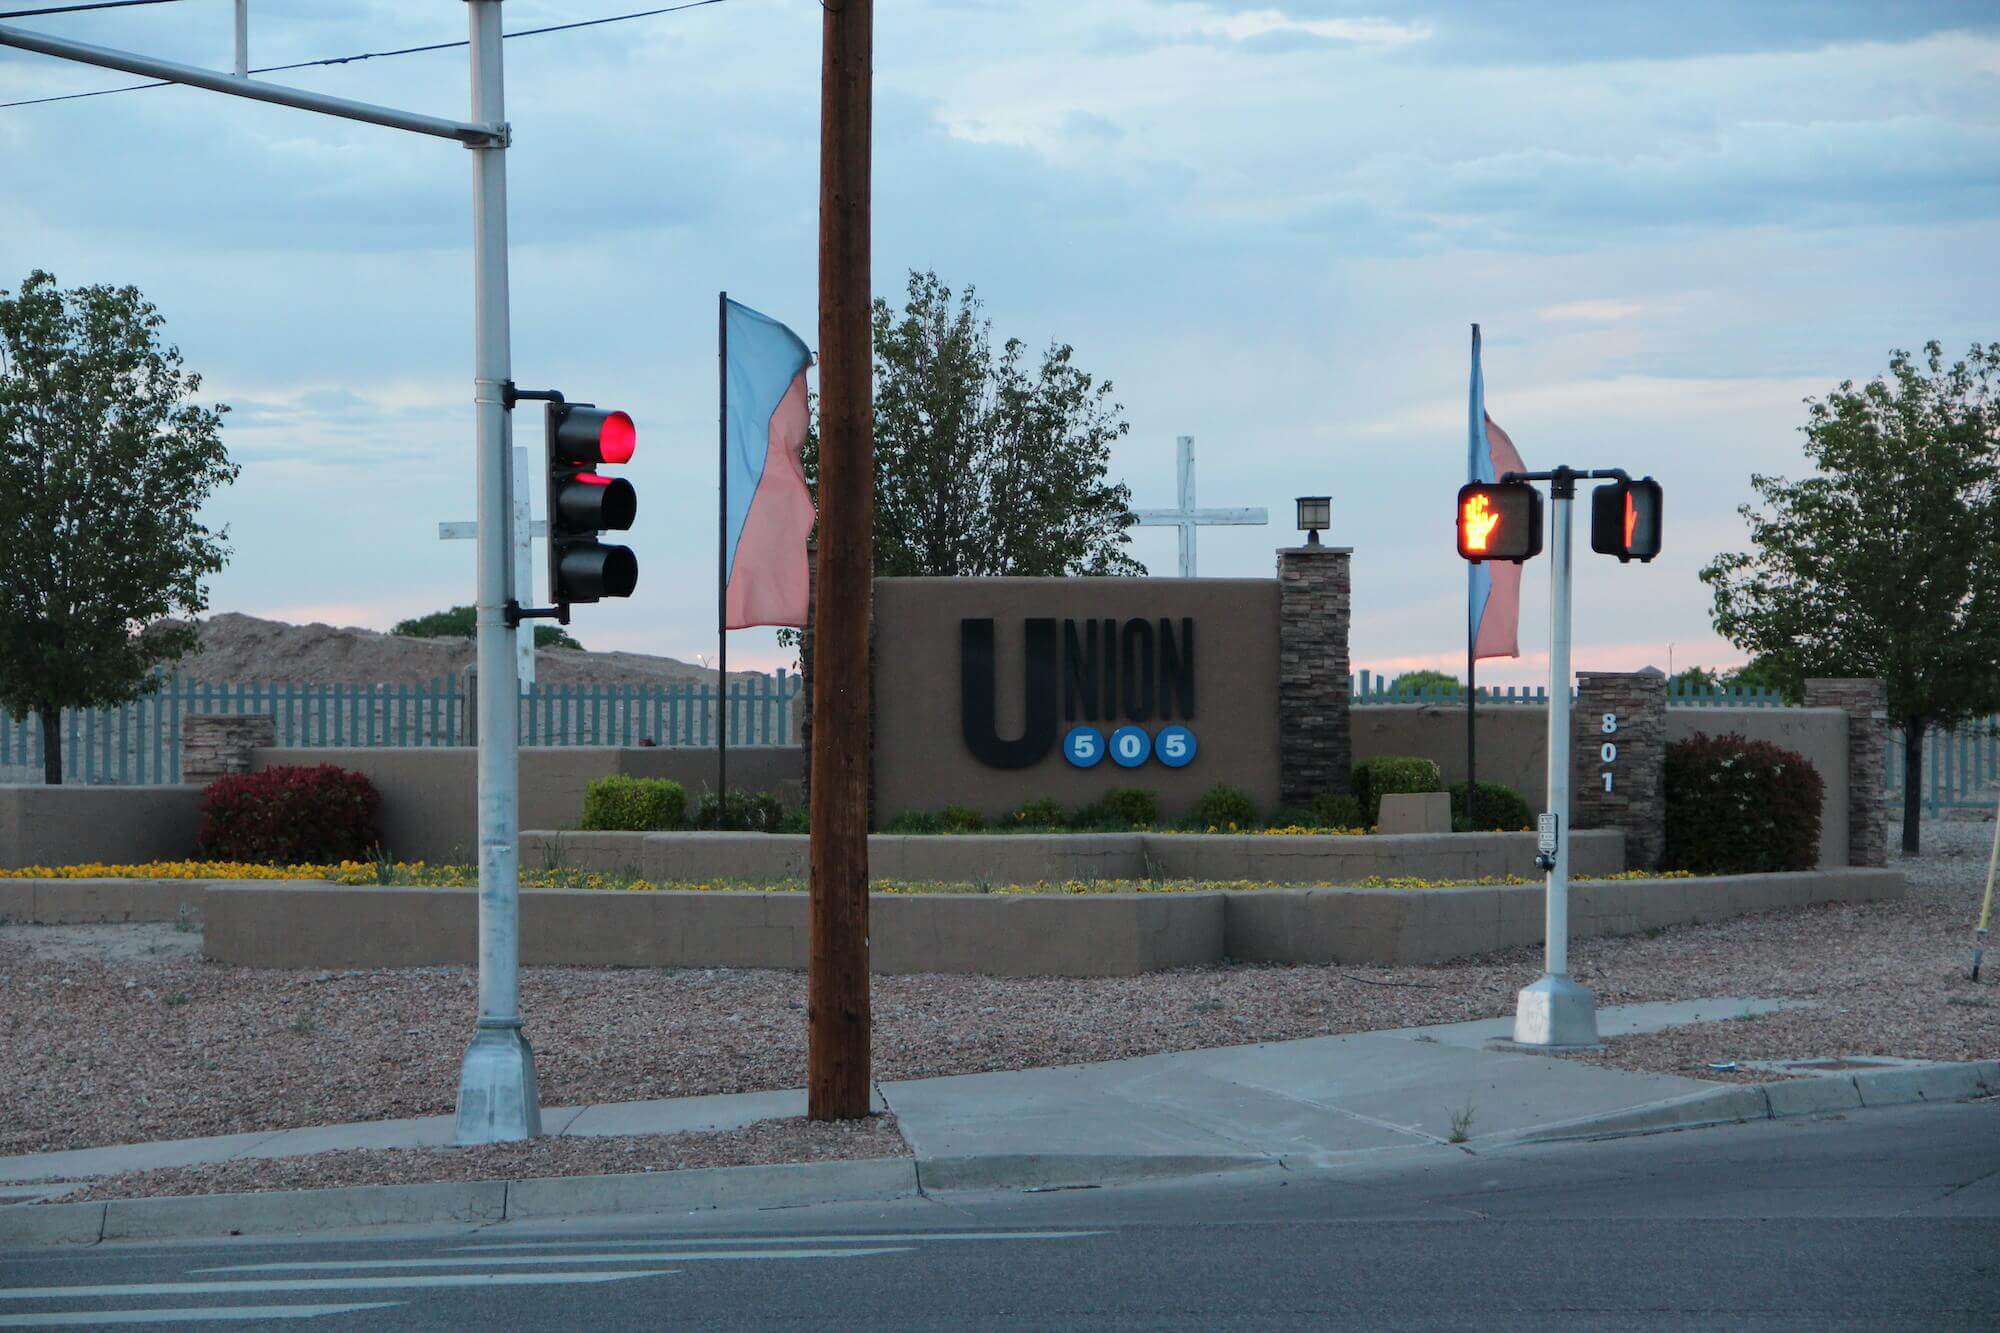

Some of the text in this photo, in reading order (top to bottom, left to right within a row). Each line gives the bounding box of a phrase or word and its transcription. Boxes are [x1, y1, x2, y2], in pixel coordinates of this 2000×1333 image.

[961, 617, 1194, 769] UNION
[1072, 733, 1188, 759] 505
[1601, 713, 1617, 792] 801
